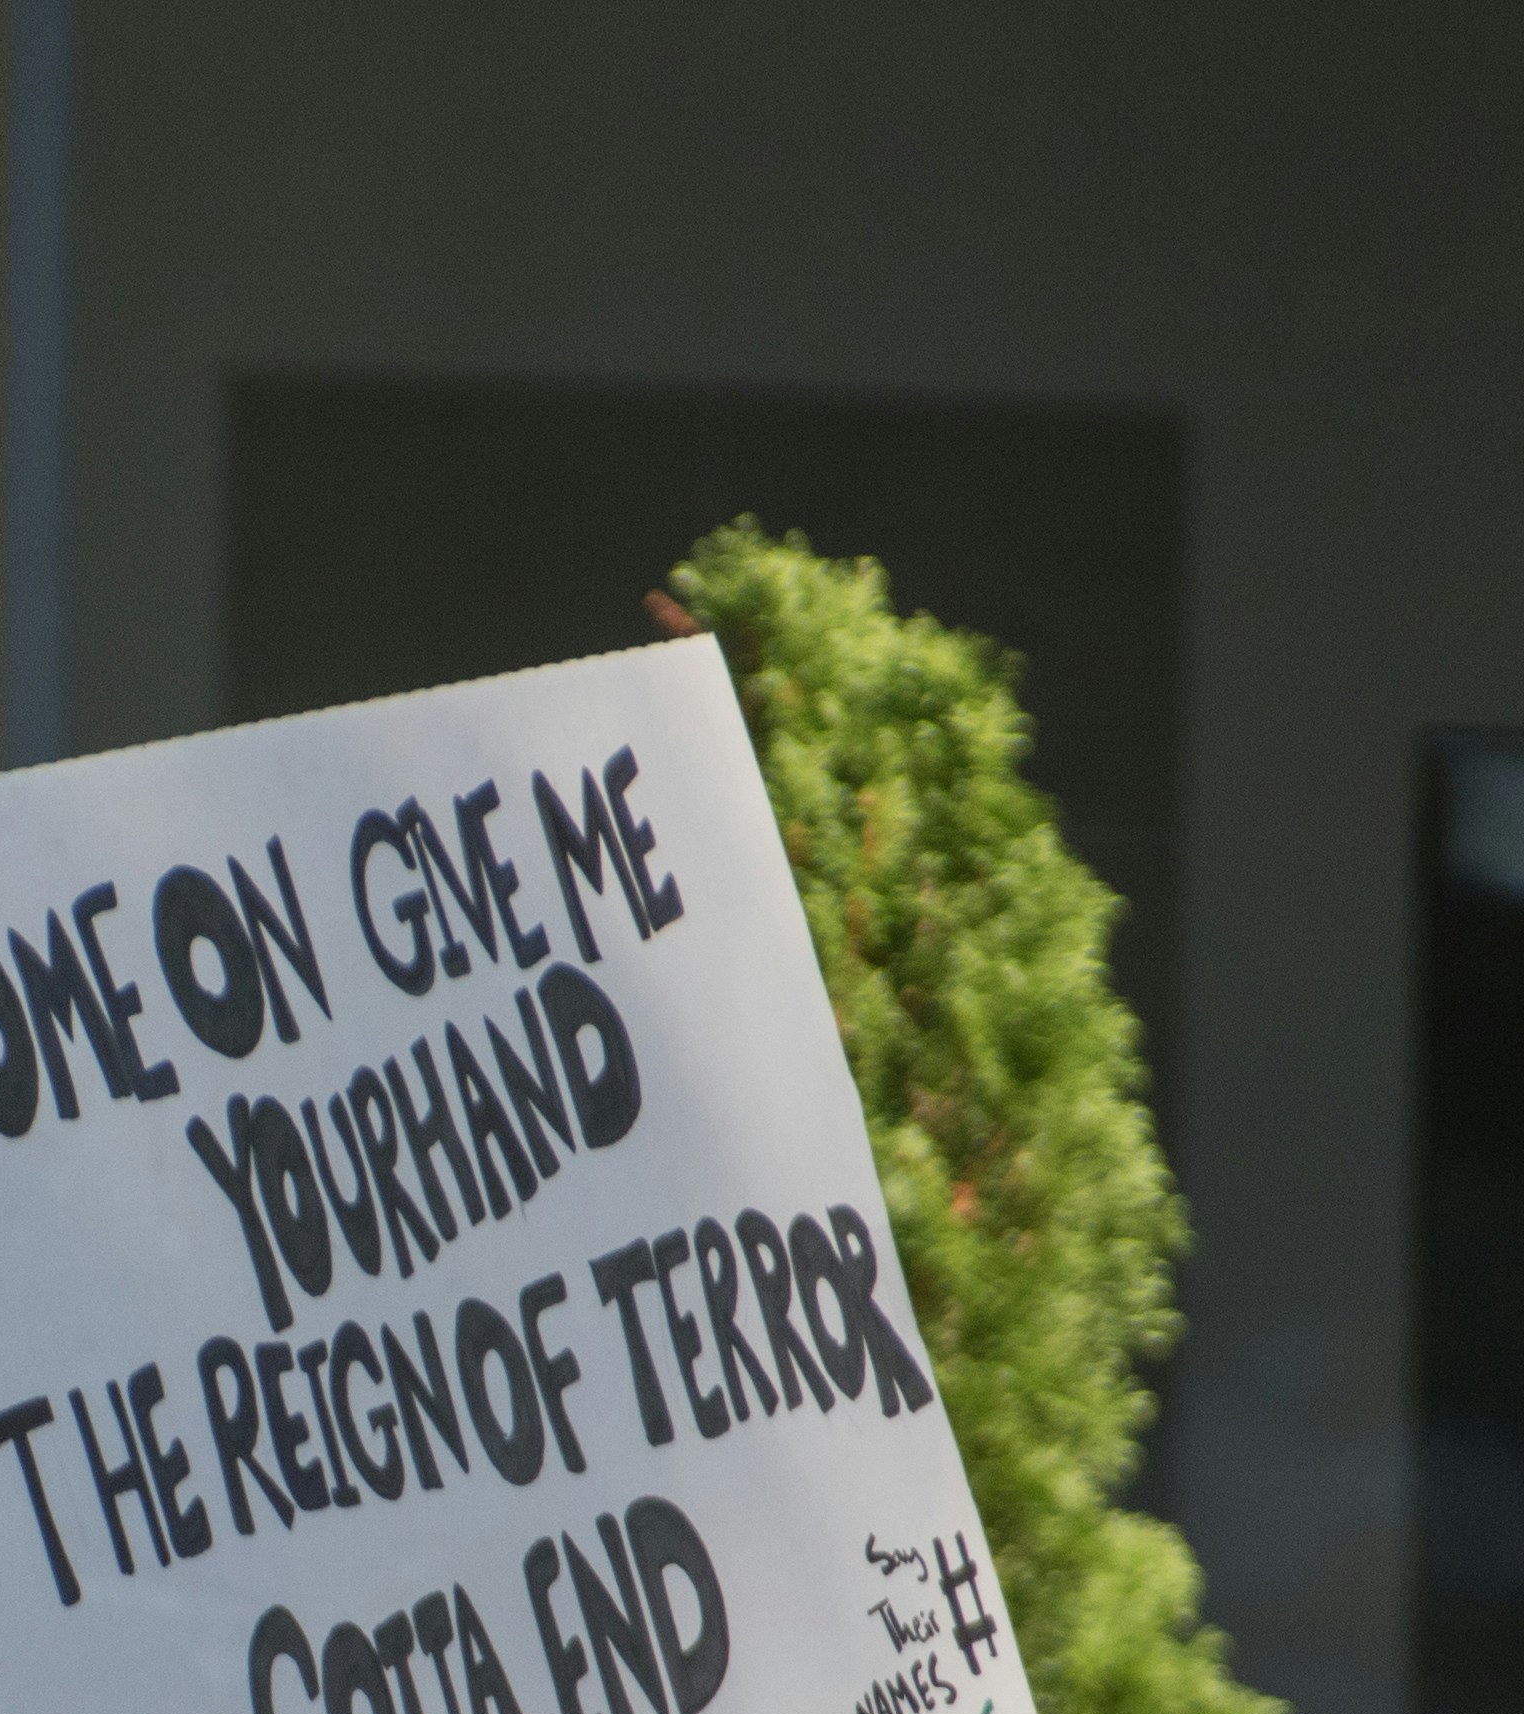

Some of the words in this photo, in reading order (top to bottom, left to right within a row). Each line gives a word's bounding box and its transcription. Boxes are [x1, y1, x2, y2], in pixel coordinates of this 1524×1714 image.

[153, 832, 333, 1059] ON
[350, 778, 549, 996] GIVE
[551, 743, 685, 963] ME
[196, 1309, 470, 1536] REIGN
[455, 1271, 586, 1487] OF
[588, 1203, 935, 1447] TERROR
[865, 1533, 928, 1582] Say
[867, 1598, 941, 1654] Their
